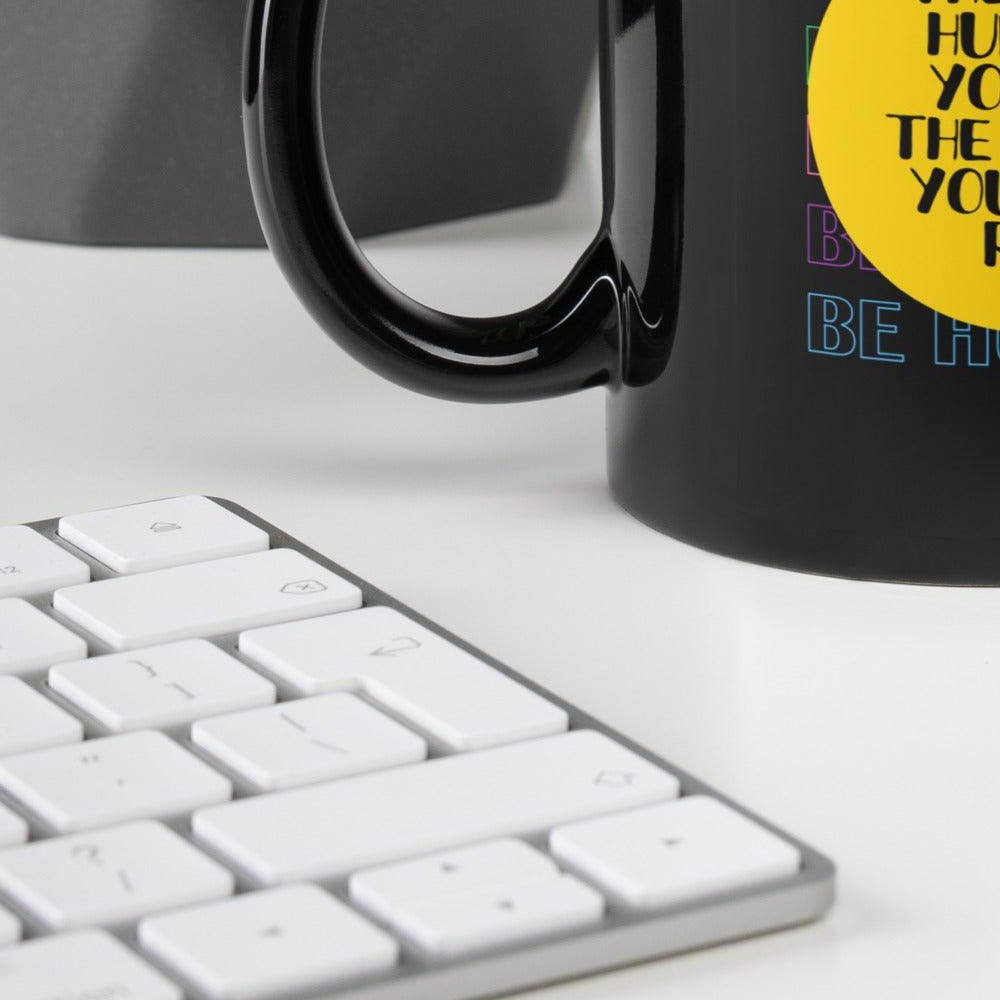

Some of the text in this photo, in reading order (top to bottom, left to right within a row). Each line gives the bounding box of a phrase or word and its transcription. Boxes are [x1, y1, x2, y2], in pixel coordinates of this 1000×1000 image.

[885, 113, 992, 162] THE
[806, 202, 878, 271] B
[806, 291, 906, 364] BE
